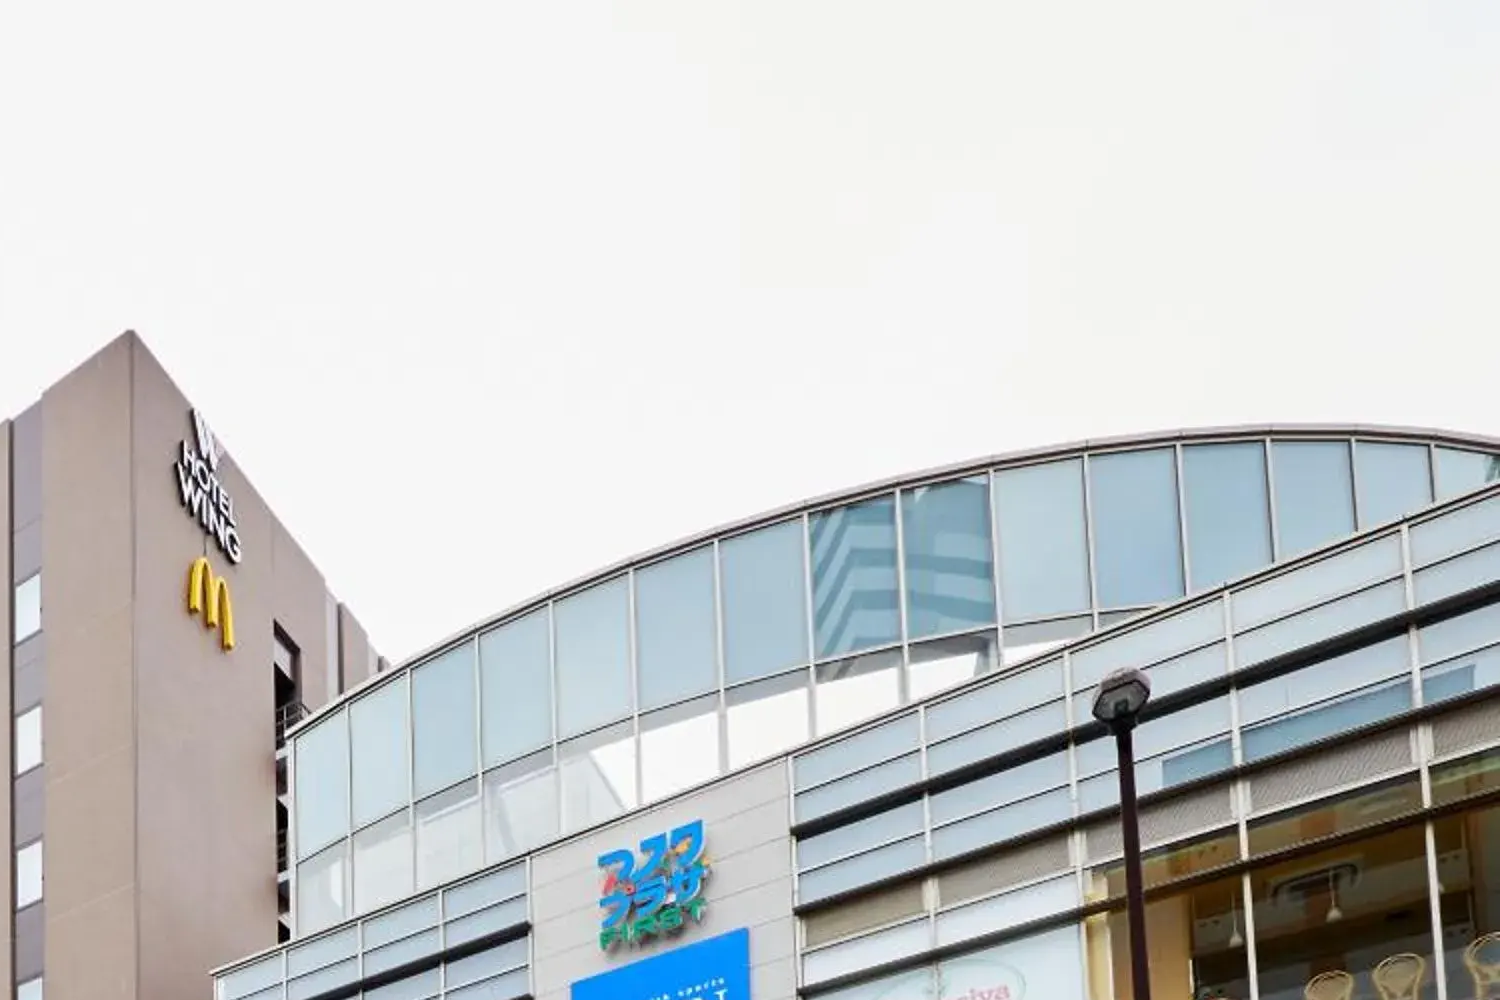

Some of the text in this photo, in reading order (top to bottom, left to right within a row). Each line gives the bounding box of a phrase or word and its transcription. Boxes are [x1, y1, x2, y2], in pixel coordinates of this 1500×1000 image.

[174, 460, 242, 564] WING
[180, 439, 236, 527] HOTEL
[598, 898, 708, 950] FIRST
[677, 976, 726, 998] sports
